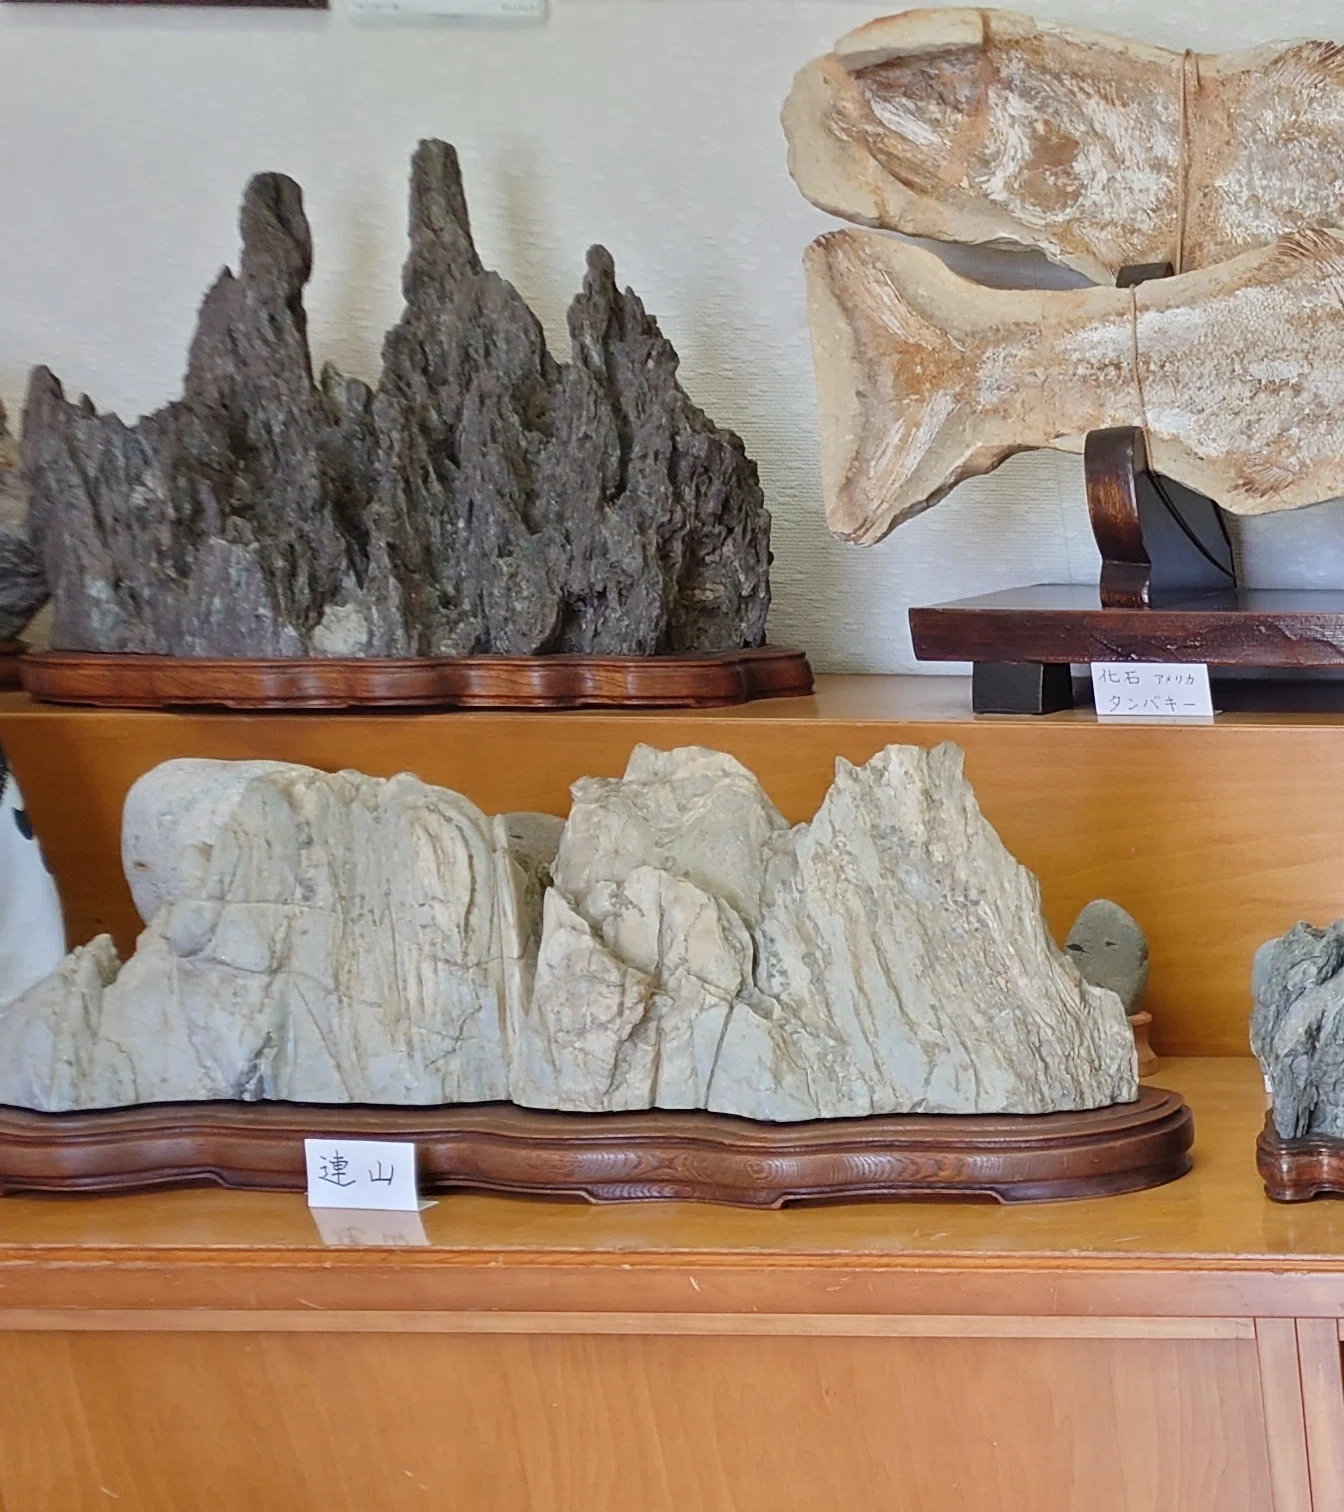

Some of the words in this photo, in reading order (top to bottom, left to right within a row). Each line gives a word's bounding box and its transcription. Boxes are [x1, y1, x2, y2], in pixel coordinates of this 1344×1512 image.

[1098, 669, 1140, 685] 化石
[1154, 674, 1195, 686] アメリカ
[318, 1150, 394, 1187] 連山
